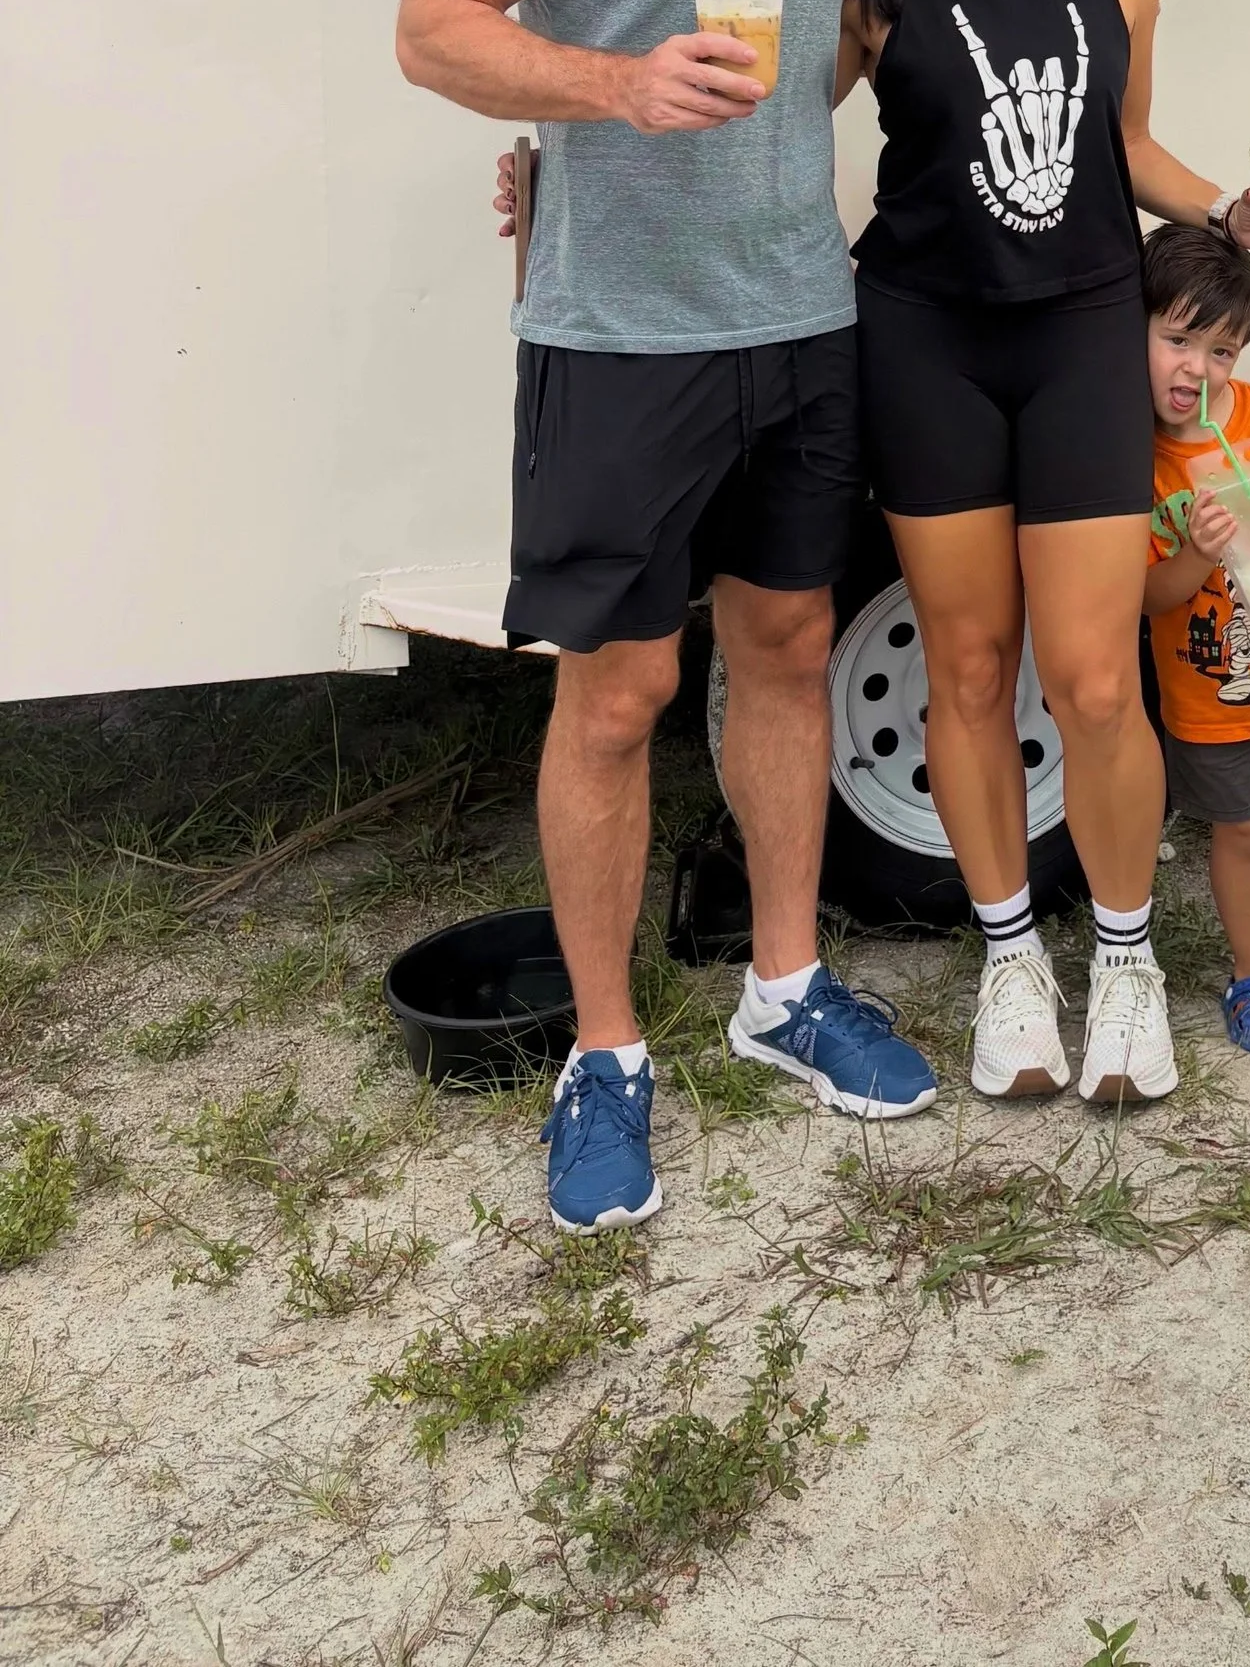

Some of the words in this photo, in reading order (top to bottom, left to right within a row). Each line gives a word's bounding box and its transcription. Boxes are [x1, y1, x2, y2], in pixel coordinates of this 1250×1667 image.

[969, 161, 1004, 219] GOTTA
[1001, 211, 1038, 233] STAY
[1039, 207, 1064, 232] FLY
